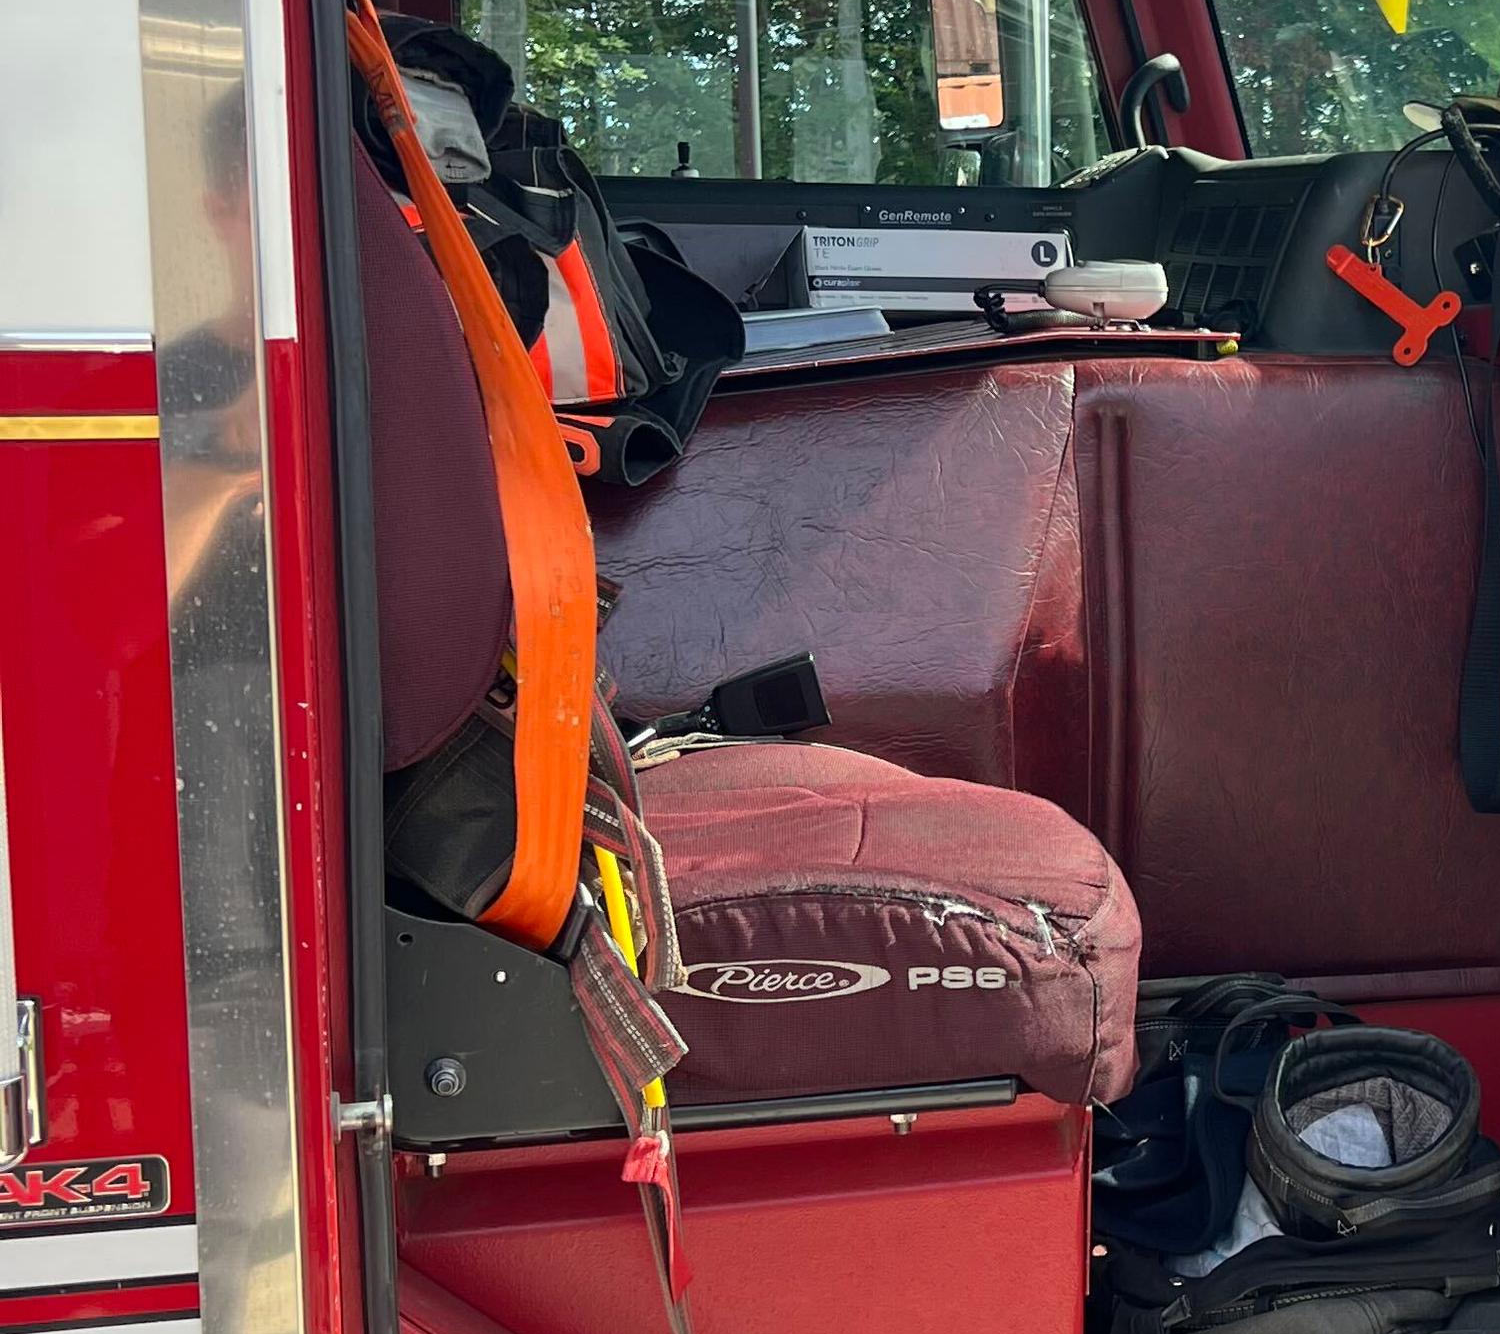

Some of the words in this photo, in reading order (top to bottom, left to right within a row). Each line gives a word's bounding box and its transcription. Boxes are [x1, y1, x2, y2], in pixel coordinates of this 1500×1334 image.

[879, 210, 952, 222] GenRemote
[813, 248, 830, 259] TE
[710, 966, 837, 995] Pierce
[908, 966, 1008, 991] PS6
